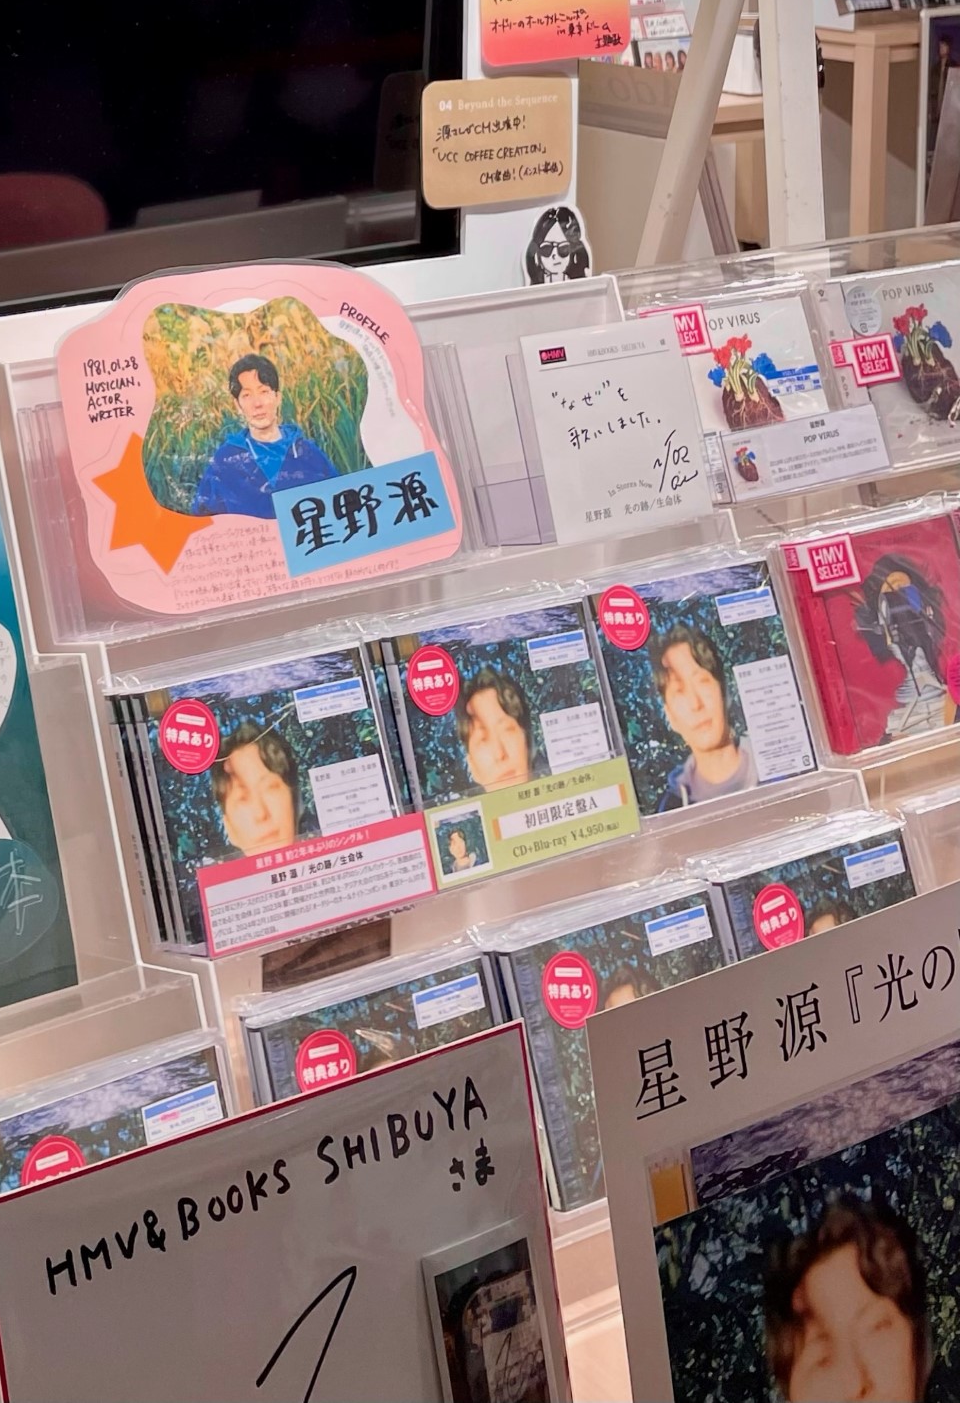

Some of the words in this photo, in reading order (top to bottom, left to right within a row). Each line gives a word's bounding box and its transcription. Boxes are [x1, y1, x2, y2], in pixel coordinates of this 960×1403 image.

[439, 99, 452, 111] 04
[458, 99, 494, 112] Beyond
[497, 96, 513, 108] the
[515, 94, 558, 108] Sequence
[464, 149, 495, 162] COFFEE
[881, 287, 902, 301] POP
[905, 282, 935, 297] VIRUS
[339, 301, 391, 346] PROFILE
[727, 311, 762, 328] VIRUS
[857, 343, 886, 361] HMV
[862, 357, 892, 374] SELECT
[89, 406, 136, 424] WRITER
[291, 470, 440, 557] 星野源
[811, 544, 844, 566] HMV
[817, 560, 849, 580] SELECT
[603, 609, 647, 627] 特典あり
[411, 673, 455, 693] 特典あり
[164, 725, 214, 749] 特典あり
[524, 796, 599, 829] 初回限定盤A
[512, 835, 569, 859] CD+Blu-ray
[759, 908, 799, 936] 特典あり
[547, 981, 593, 1001] 特典あり
[301, 1058, 351, 1084] 特典あり
[317, 1075, 490, 1185] SHIBUYA
[449, 1138, 496, 1193] さま
